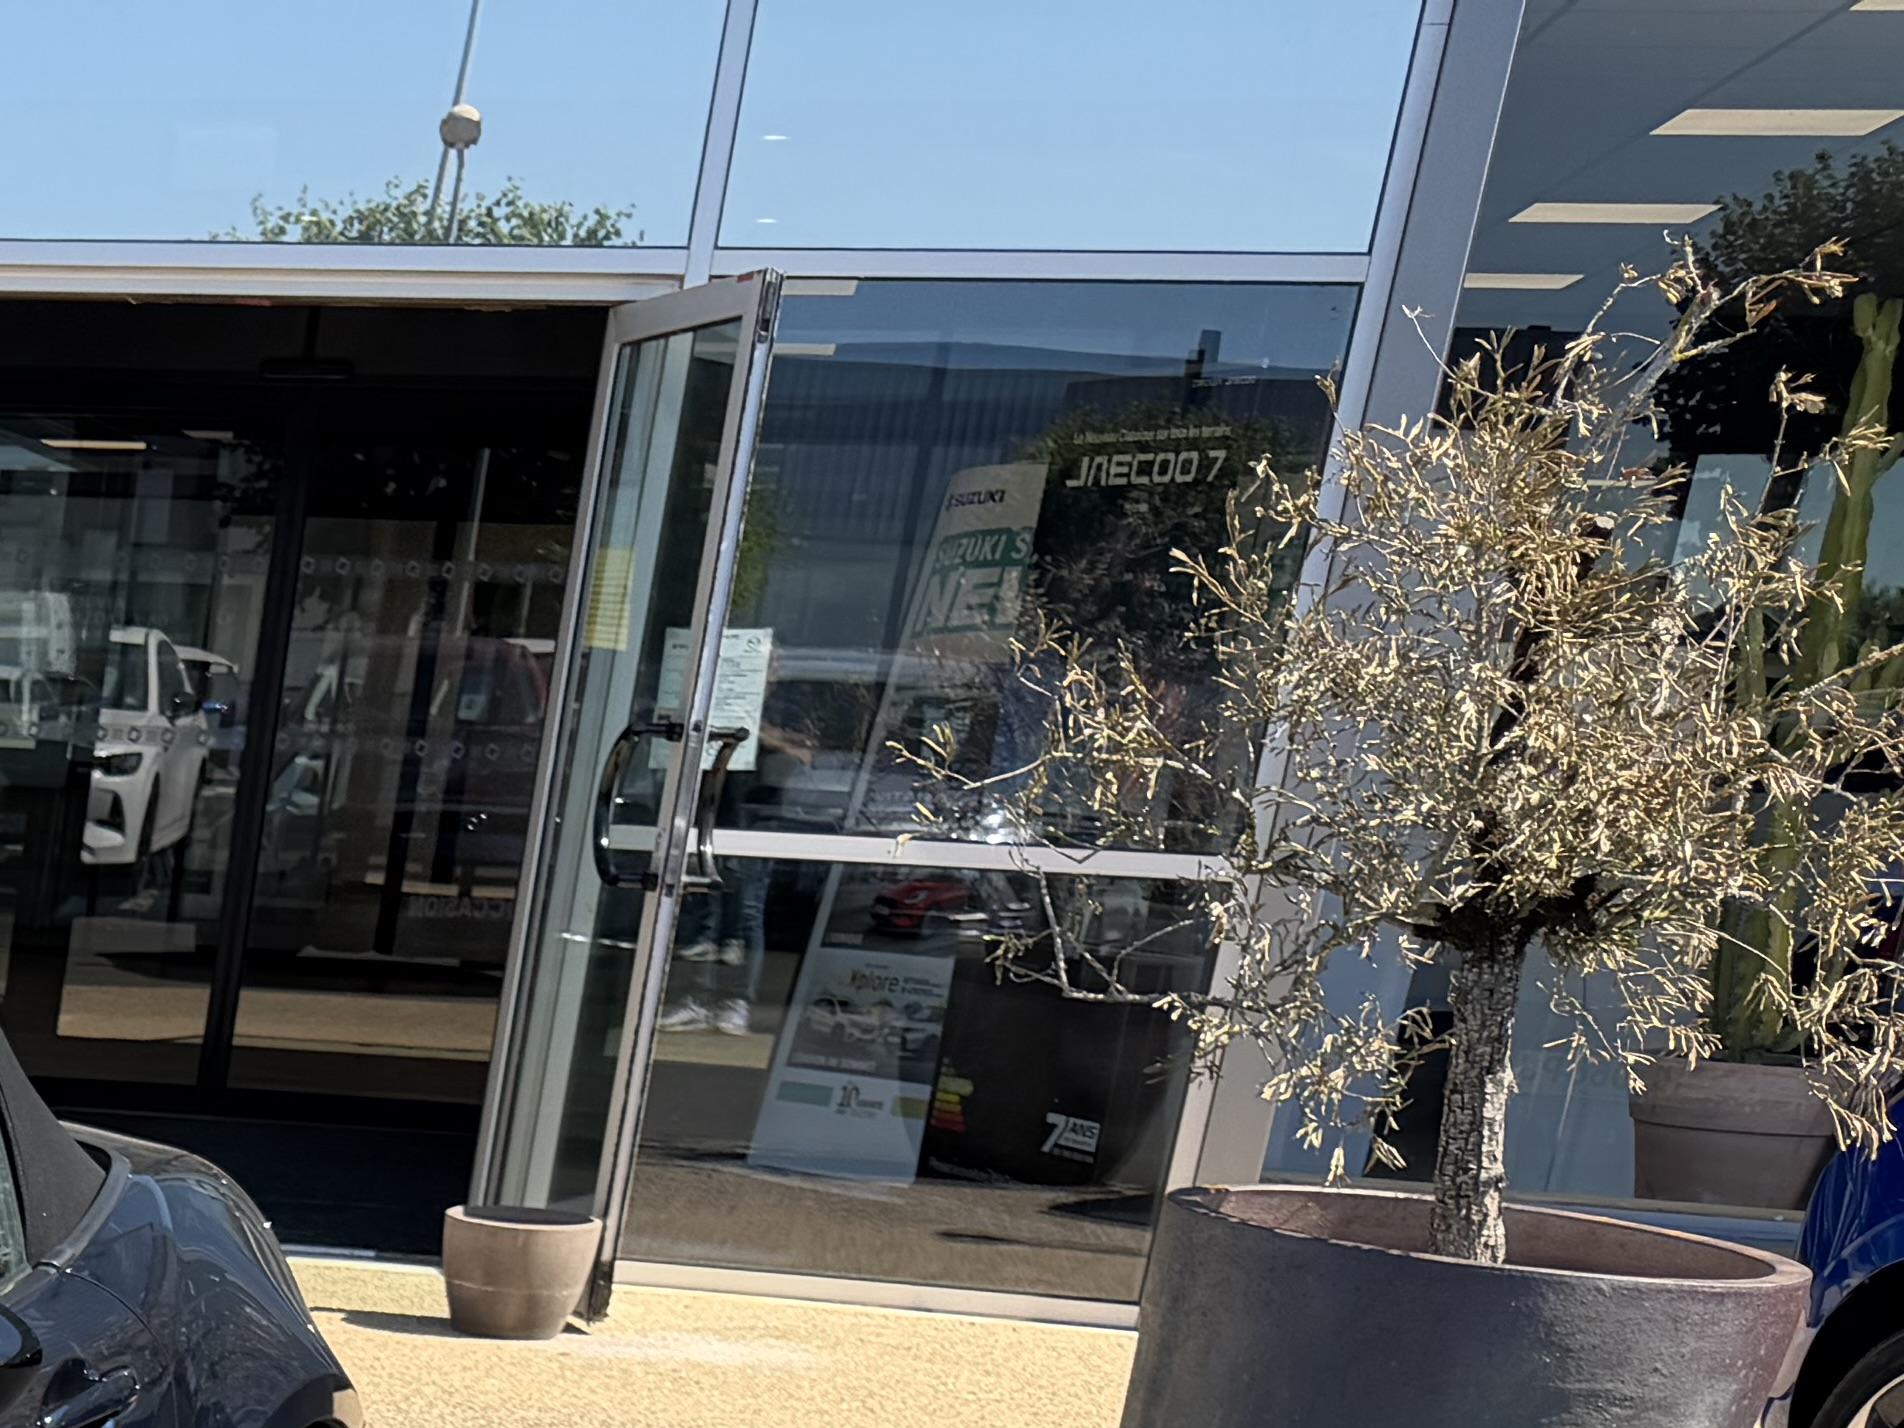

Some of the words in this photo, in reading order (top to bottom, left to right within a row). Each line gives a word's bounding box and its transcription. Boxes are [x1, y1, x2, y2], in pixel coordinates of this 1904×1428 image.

[1065, 451, 1199, 488] JAECOO
[1206, 450, 1227, 482] 7
[953, 488, 1006, 508] SUZUKI
[1040, 1111, 1067, 1153] 7
